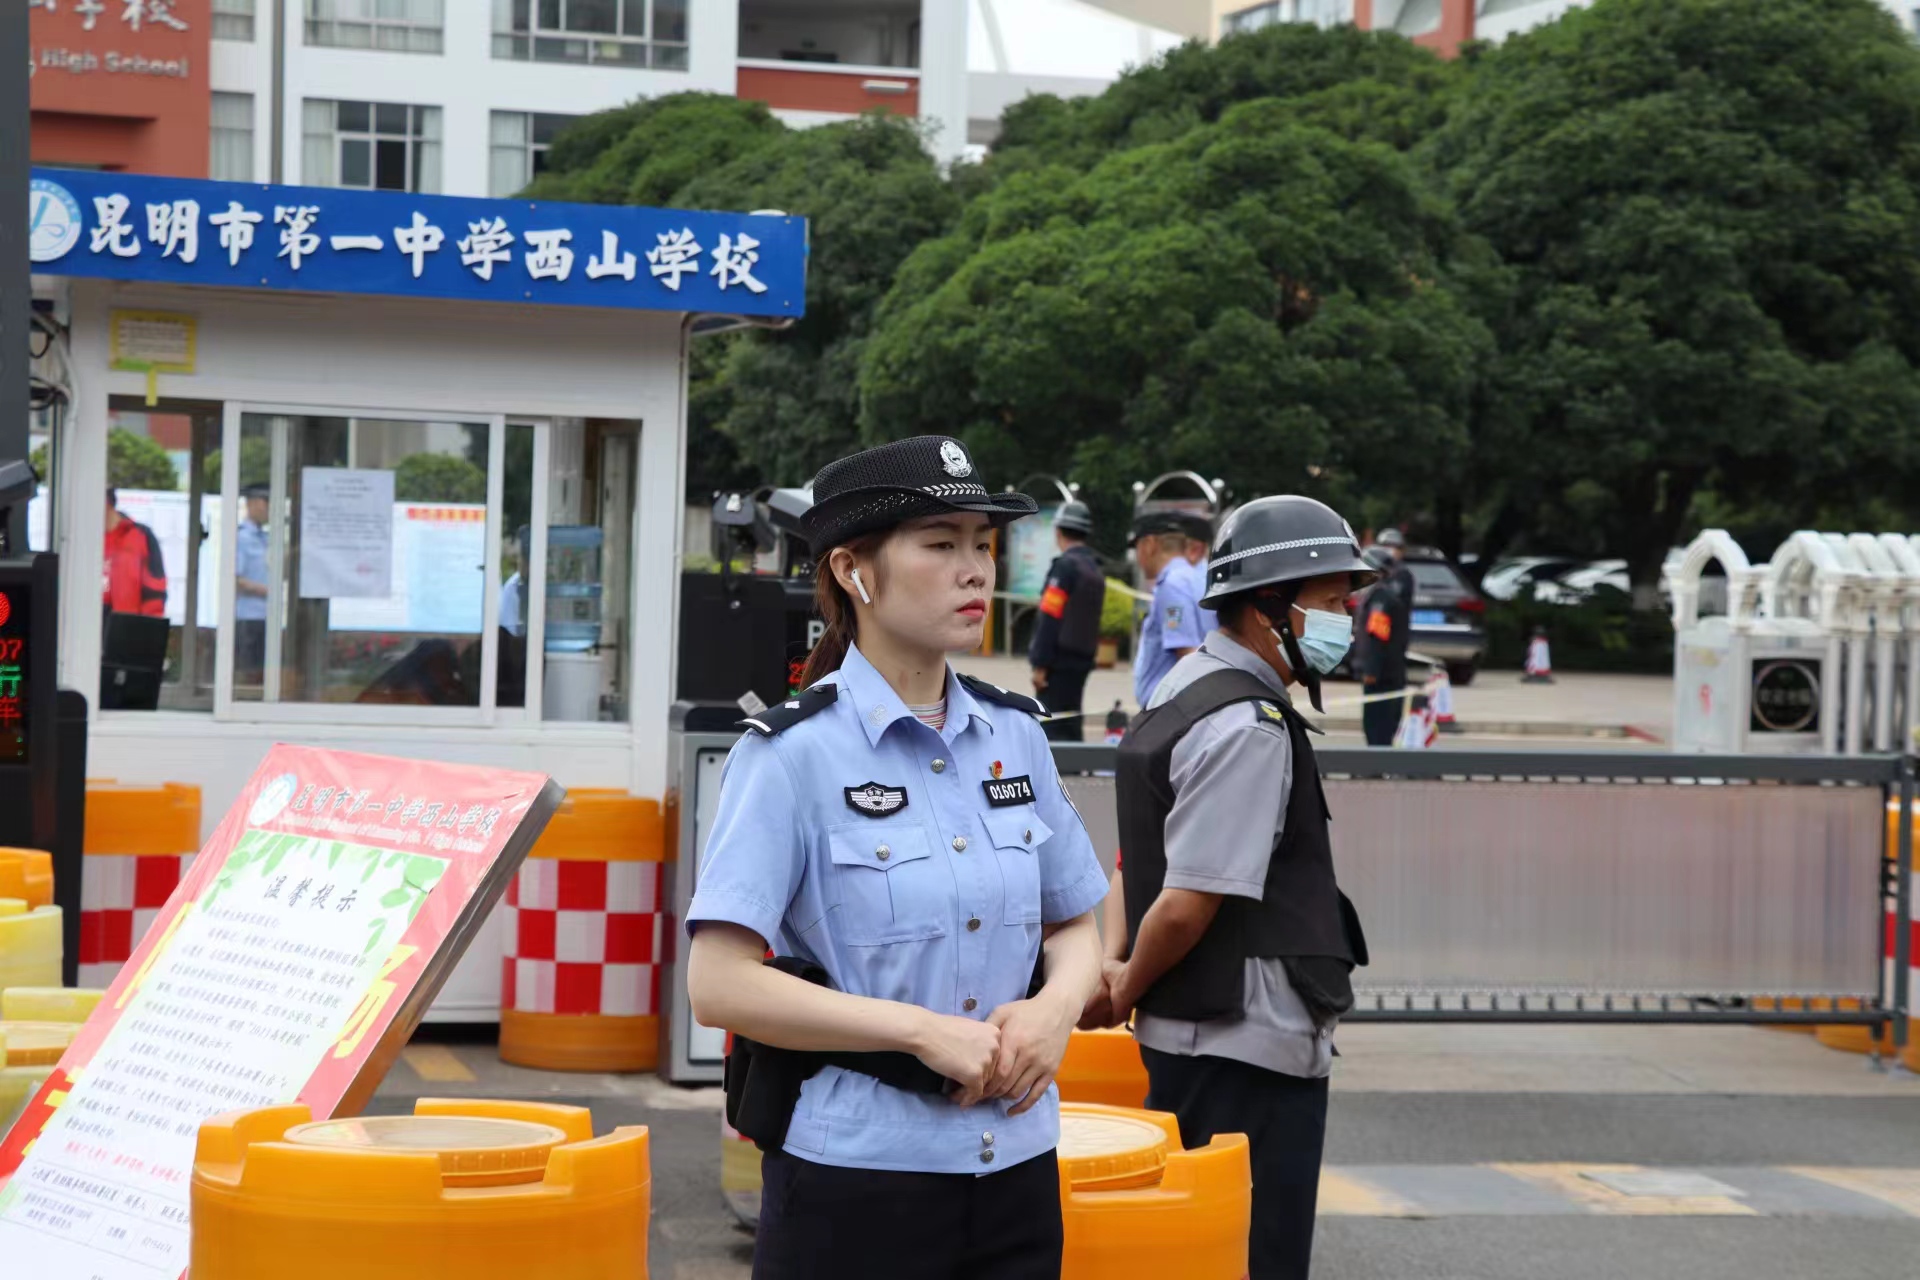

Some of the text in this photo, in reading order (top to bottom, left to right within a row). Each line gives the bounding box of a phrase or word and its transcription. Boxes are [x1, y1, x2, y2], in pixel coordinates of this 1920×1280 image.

[42, 49, 98, 73] High
[104, 51, 188, 77] School
[90, 193, 768, 295] 昆明市第一中学西山学校
[989, 781, 1031, 800] 016074
[292, 784, 501, 838] 昆明市第一中学西山学校
[263, 875, 358, 913] 温馨提示
